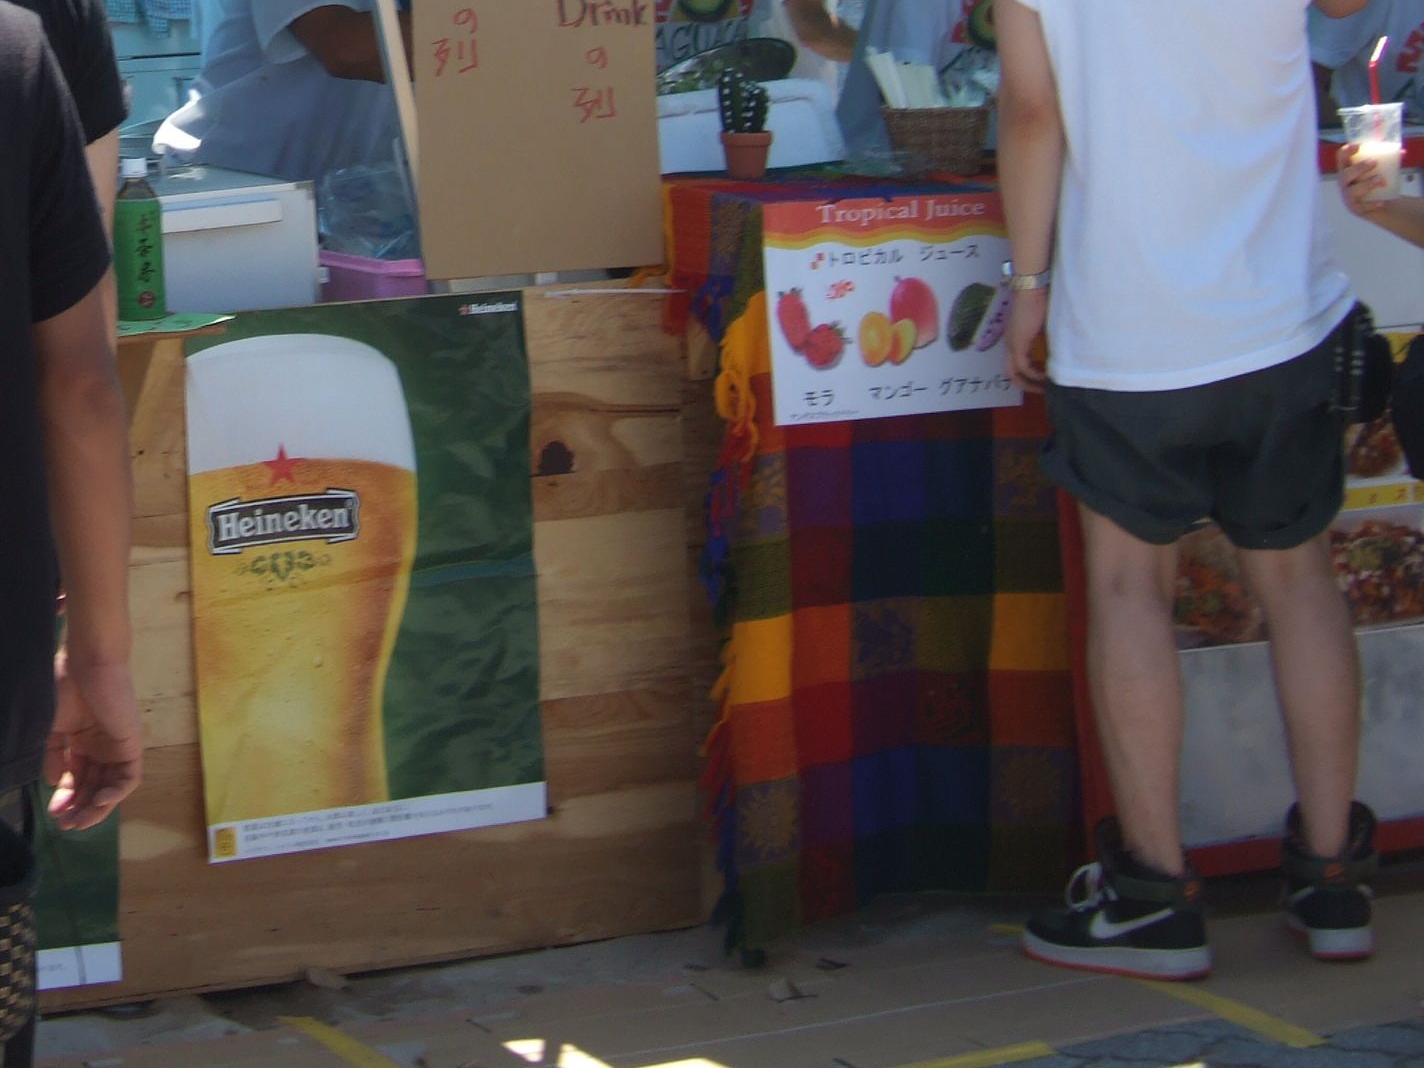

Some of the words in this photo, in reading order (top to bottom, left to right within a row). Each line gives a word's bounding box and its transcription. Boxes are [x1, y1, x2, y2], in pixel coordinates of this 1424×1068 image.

[815, 201, 919, 227] Tropical
[925, 199, 986, 221] Juice
[828, 247, 904, 268] トロピカル
[919, 243, 981, 263] ジュース
[803, 388, 836, 408] モラ
[869, 380, 929, 401] マンゴー
[217, 503, 350, 541] Heineken
